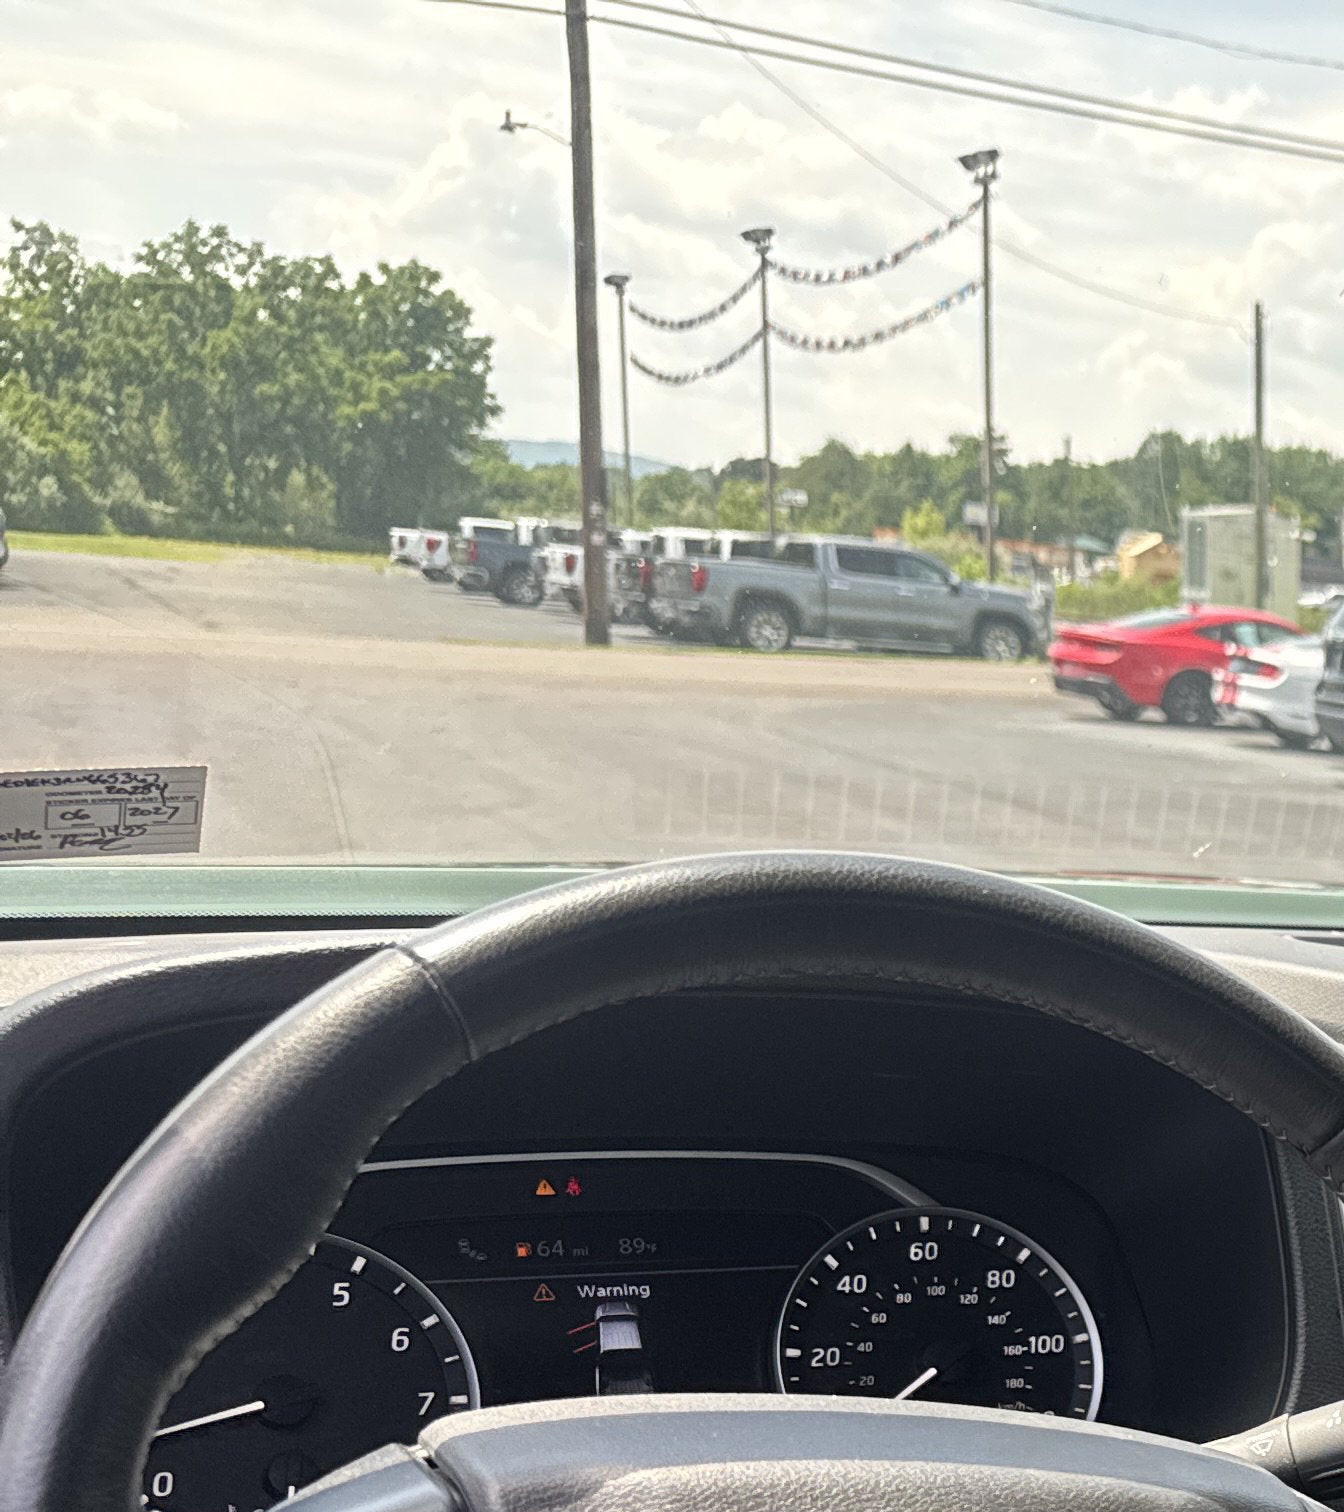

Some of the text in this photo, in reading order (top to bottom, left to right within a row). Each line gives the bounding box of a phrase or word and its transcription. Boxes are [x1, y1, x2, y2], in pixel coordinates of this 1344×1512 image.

[537, 1239, 589, 1257] 64 mi
[908, 1241, 939, 1261] 60
[836, 1274, 867, 1294] 40
[986, 1269, 1015, 1289] 80
[332, 1282, 351, 1307] 5
[577, 1283, 651, 1299] Warning
[895, 1292, 912, 1304] 80
[925, 1285, 946, 1297] 100
[959, 1293, 979, 1305] 120
[871, 1312, 887, 1324] 60
[986, 1314, 1007, 1326] 140
[390, 1327, 410, 1352] 6
[857, 1341, 873, 1353] 40
[1027, 1334, 1065, 1354] 100
[810, 1347, 841, 1367] 20
[1002, 1345, 1023, 1356] 160
[859, 1375, 875, 1387] 20
[1005, 1378, 1025, 1389] 180
[417, 1391, 435, 1416] 7
[152, 1471, 174, 1497] 0
